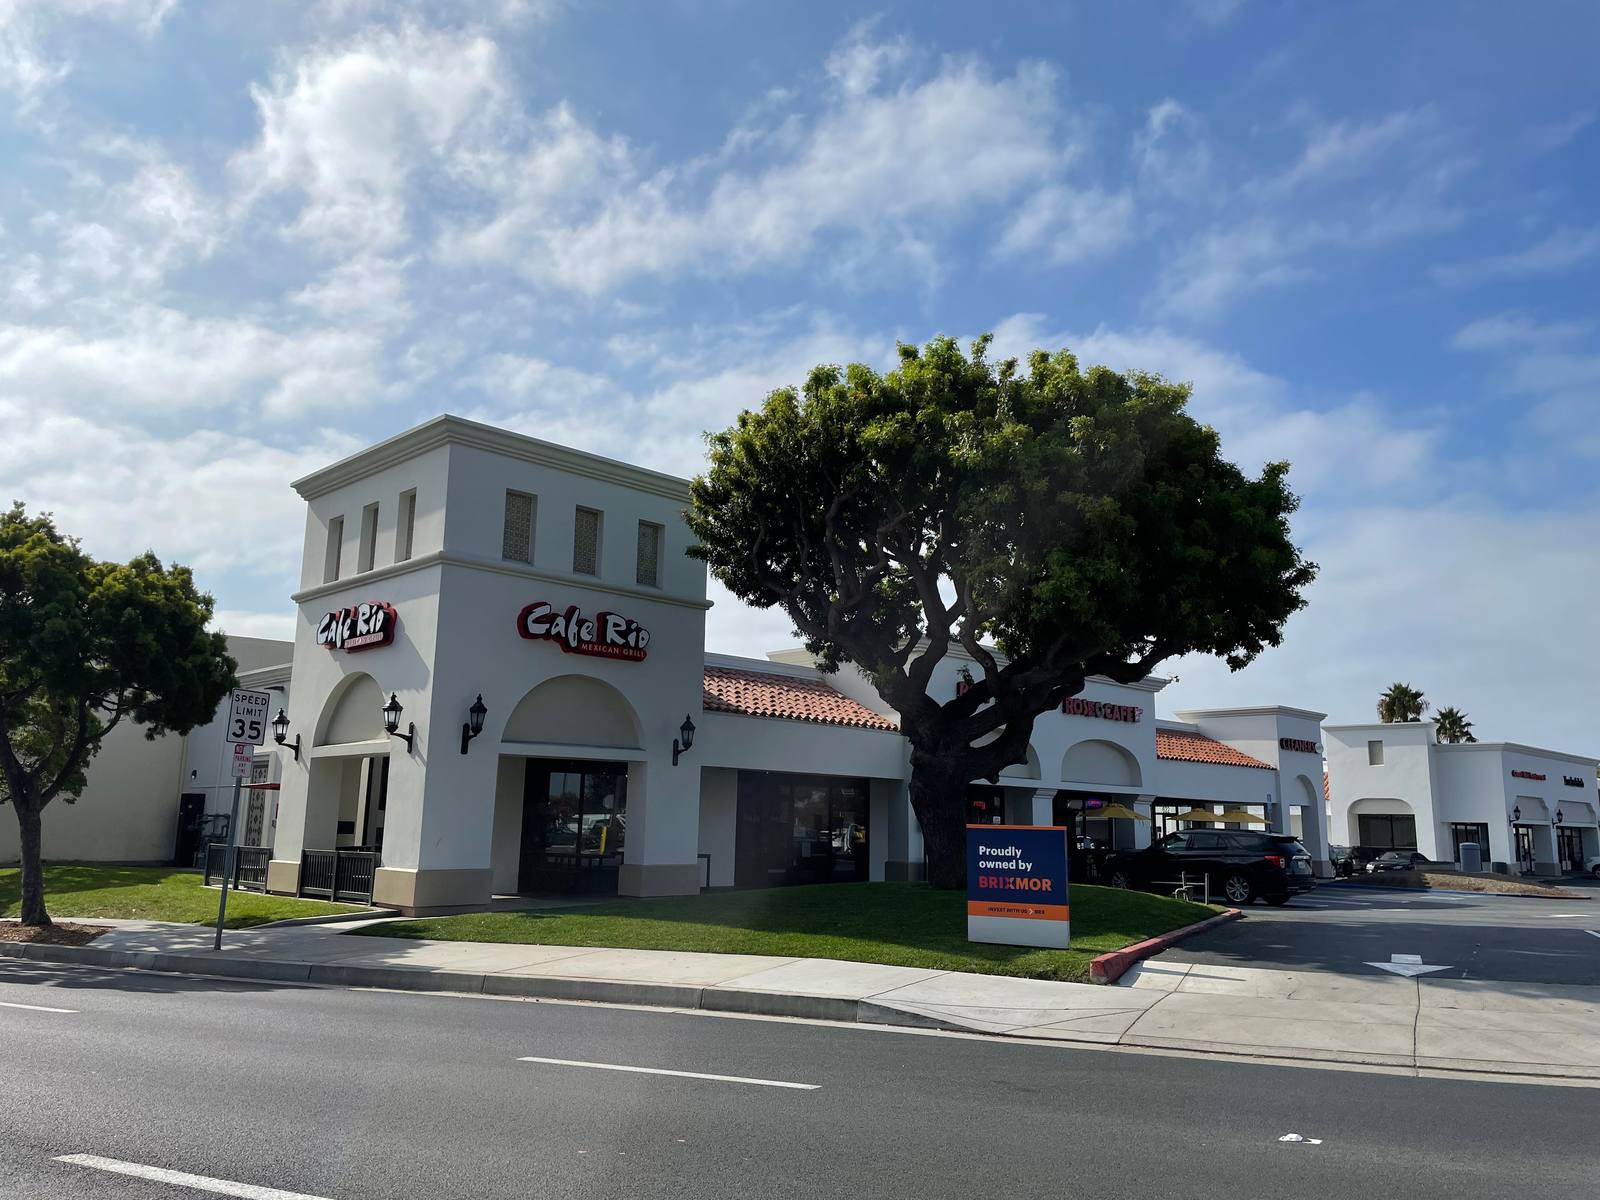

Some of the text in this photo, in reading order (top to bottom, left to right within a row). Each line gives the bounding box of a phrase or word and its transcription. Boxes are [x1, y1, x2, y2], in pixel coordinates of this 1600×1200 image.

[317, 602, 385, 649] Cafe Rio
[527, 604, 651, 649] Cafe Rio
[581, 642, 645, 658] MEXICAN GRILL
[234, 694, 267, 706] SPEED
[236, 706, 263, 717] LIMIT
[1065, 697, 1136, 722] ROSE CAFE
[231, 719, 261, 740] 35
[978, 846, 1022, 858] Proudly
[979, 859, 1033, 872] owned by
[978, 876, 1052, 891] BRIXMOR
